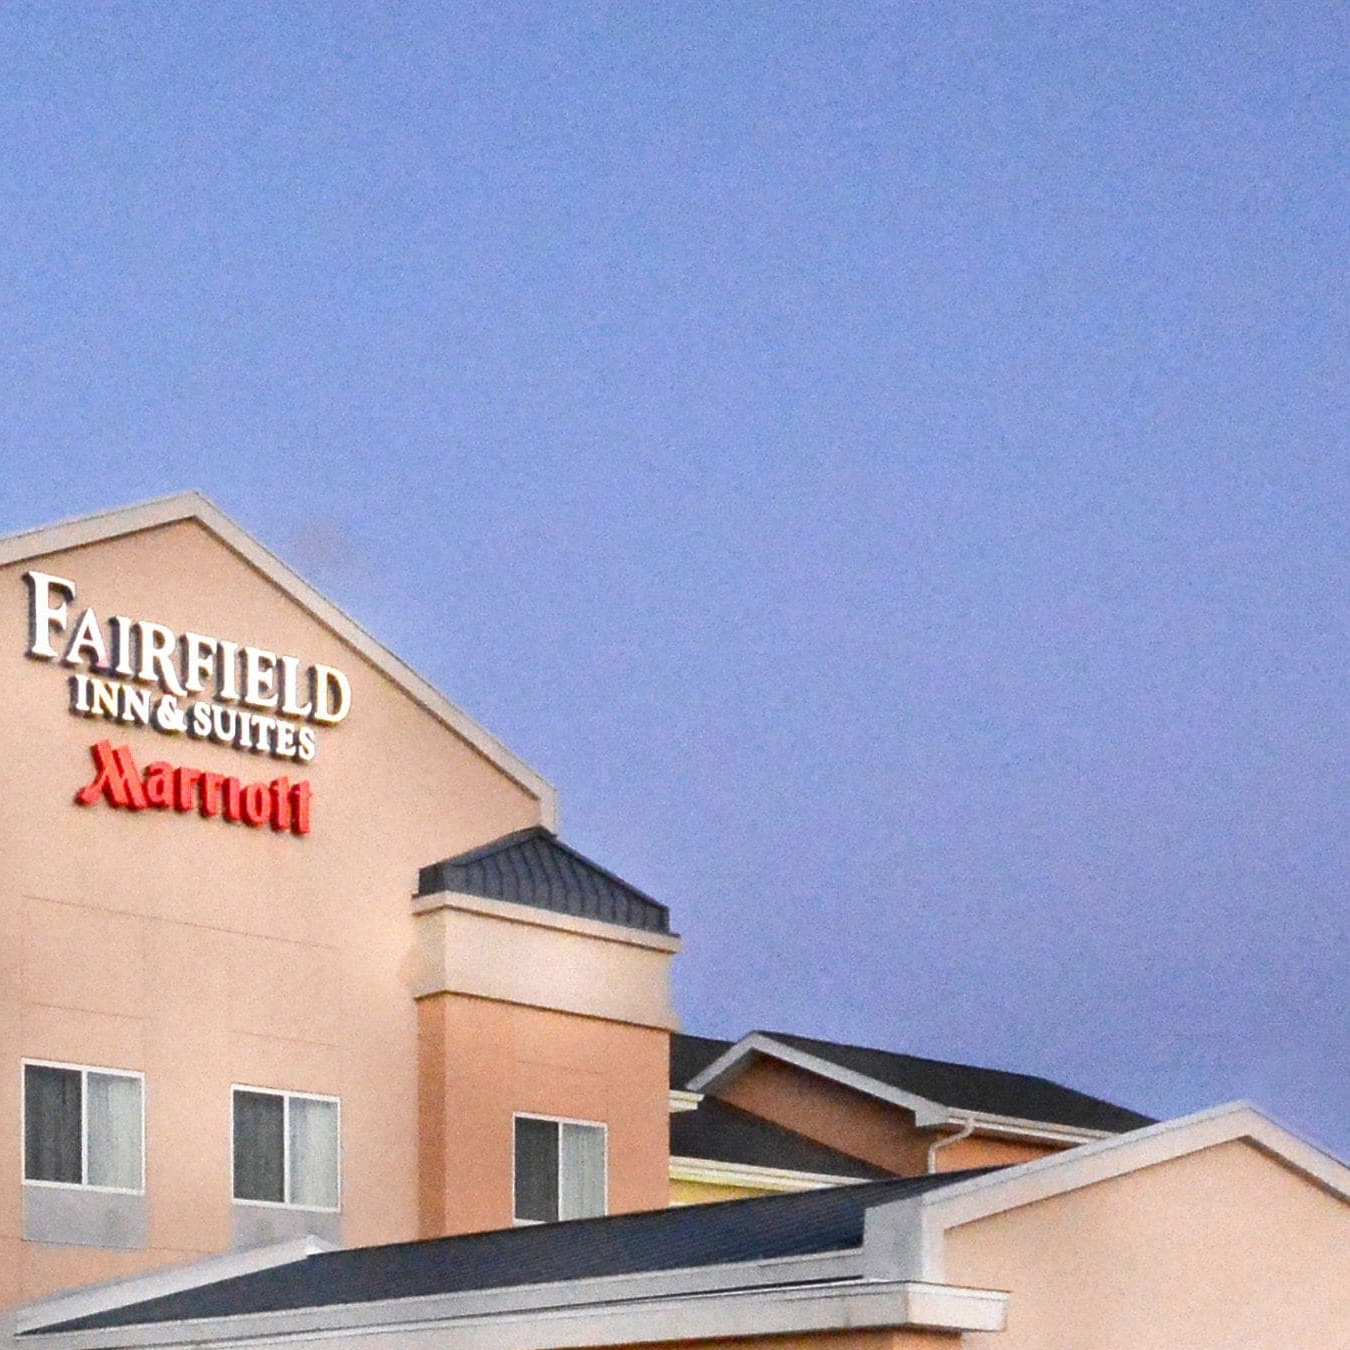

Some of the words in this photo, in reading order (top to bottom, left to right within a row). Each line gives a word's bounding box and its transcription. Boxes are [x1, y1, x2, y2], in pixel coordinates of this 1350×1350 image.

[24, 570, 352, 725] FAIRFIELD
[71, 674, 151, 725] INN
[156, 695, 188, 733] &
[192, 701, 316, 762] SUITES
[76, 739, 312, 835] Marriott
